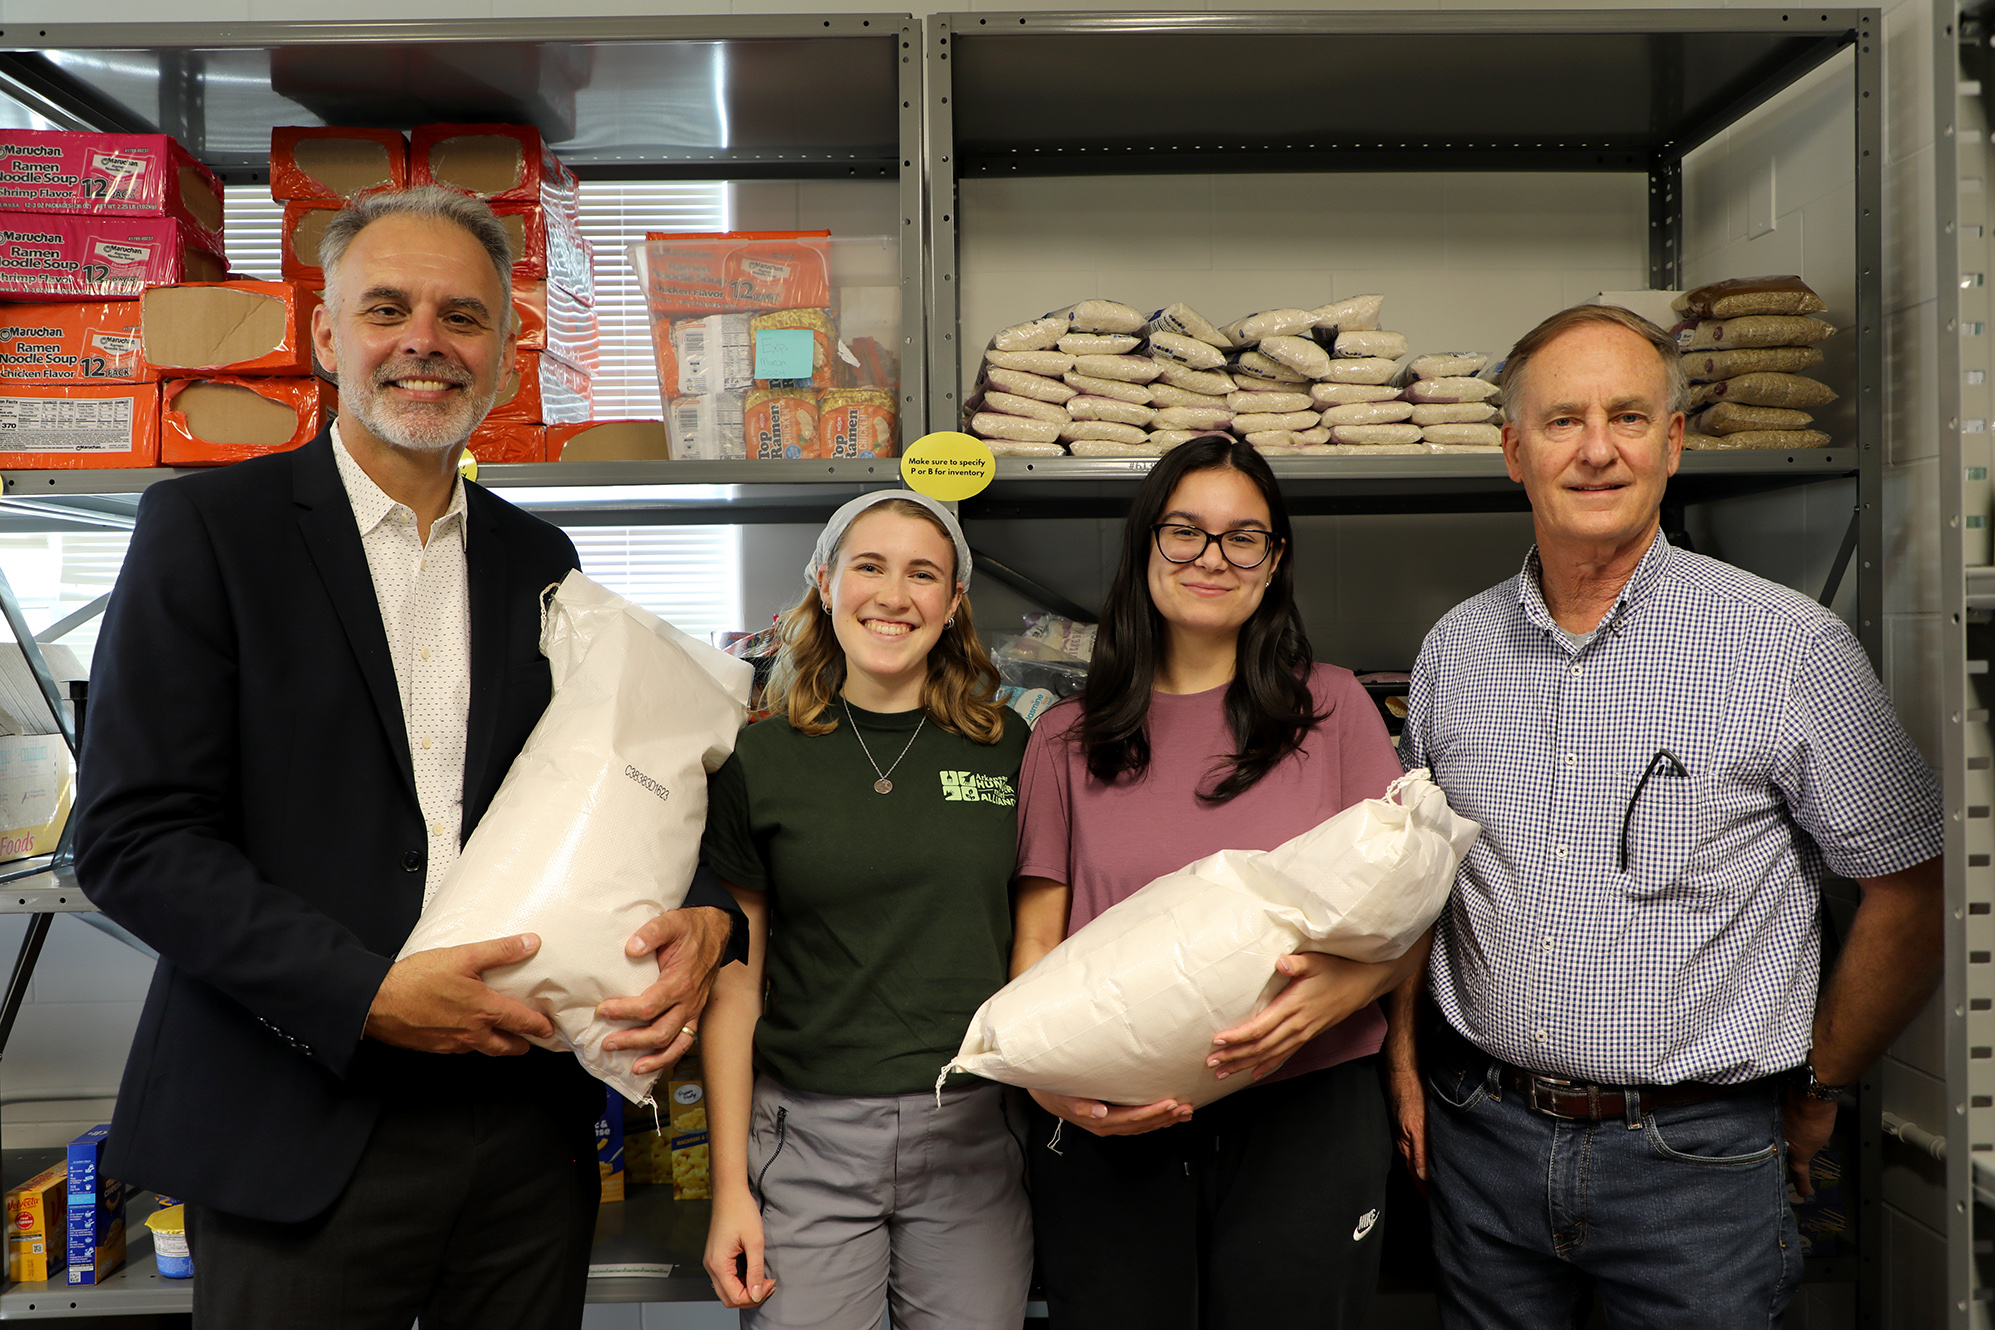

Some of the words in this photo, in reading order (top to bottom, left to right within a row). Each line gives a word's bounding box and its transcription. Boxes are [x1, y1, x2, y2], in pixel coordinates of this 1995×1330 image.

[4, 144, 62, 156] Maruchan
[12, 160, 60, 172] Ramen
[108, 157, 138, 166] Marucan
[43, 172, 78, 187] Soup
[39, 188, 74, 198] Flavor
[81, 177, 108, 198] 12
[111, 189, 135, 199] ACK
[4, 230, 64, 244] Maruchan
[10, 246, 60, 258] Ramen
[111, 245, 142, 254] Maruchan
[0, 257, 41, 268] oodle
[43, 258, 79, 272] Soup
[0, 272, 36, 285] hrimp
[38, 274, 74, 284] Flavor
[81, 264, 111, 284] 12
[652, 267, 694, 282] Noodle
[653, 283, 691, 295] Chicken
[693, 289, 724, 298] Flavor
[729, 280, 754, 300] 12
[10, 326, 64, 337] Maruchan
[16, 342, 61, 353] Ramen
[0, 353, 43, 364] Noodle
[45, 353, 78, 367] Soup
[760, 357, 787, 366] March
[0, 369, 41, 379] Chicken
[43, 369, 75, 378] Flavor
[80, 357, 106, 378] 12
[107, 368, 131, 378] PACK
[770, 402, 782, 459] Ramen
[781, 408, 792, 445] CHICKEN
[859, 414, 868, 450] CHICKEN
[758, 431, 772, 459] Top
[959, 458, 986, 467] specify
[947, 469, 985, 477] inventory
[1025, 693, 1044, 721] Jasmine
[0, 831, 36, 857] Foods
[8, 1197, 39, 1211] Velveeta
[1358, 1208, 1376, 1230] NIKE
